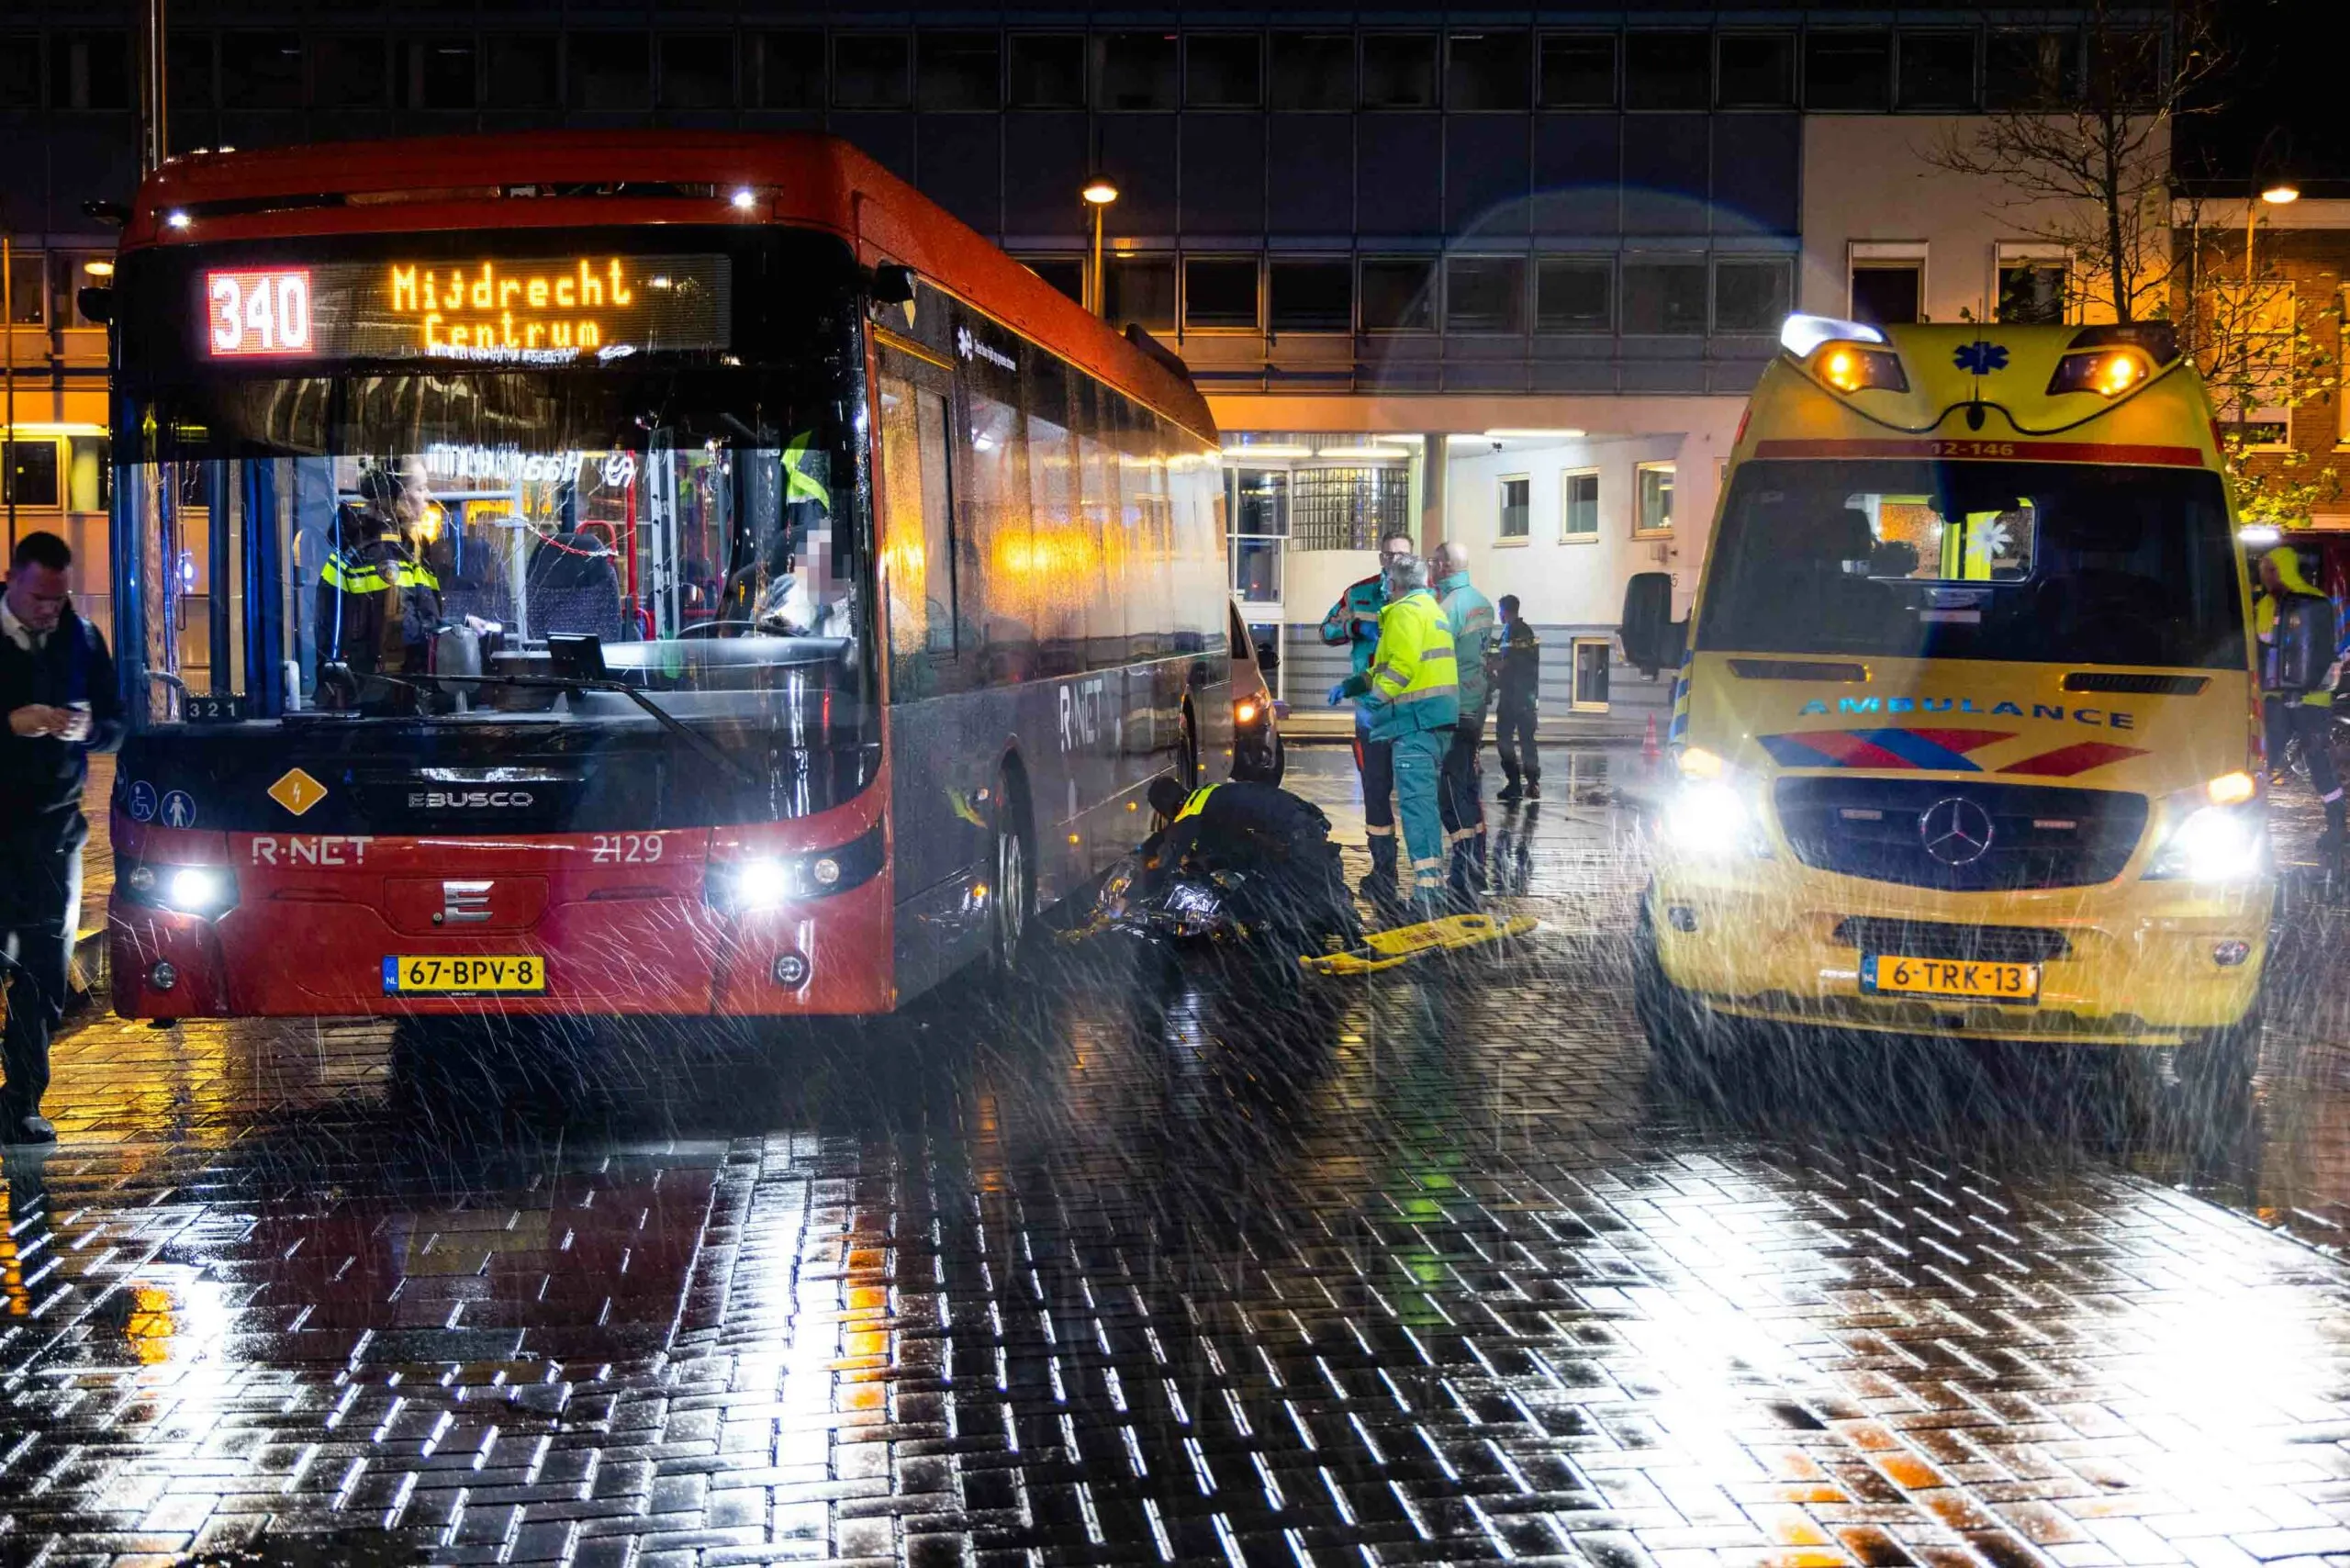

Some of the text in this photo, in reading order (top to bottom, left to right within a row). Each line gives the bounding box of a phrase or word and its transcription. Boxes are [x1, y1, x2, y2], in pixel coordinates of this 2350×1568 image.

[392, 259, 631, 310] Mijdrecht
[212, 276, 308, 349] 340
[424, 313, 599, 348] Centrum
[1930, 442, 2014, 456] 12-146
[1799, 697, 2135, 730] AMBULANCE
[408, 792, 533, 807] EBUSCO
[592, 835, 663, 863] 2129
[386, 961, 533, 985] NL 67-BPV-8
[1893, 962, 2021, 991] 6-TRK-13
